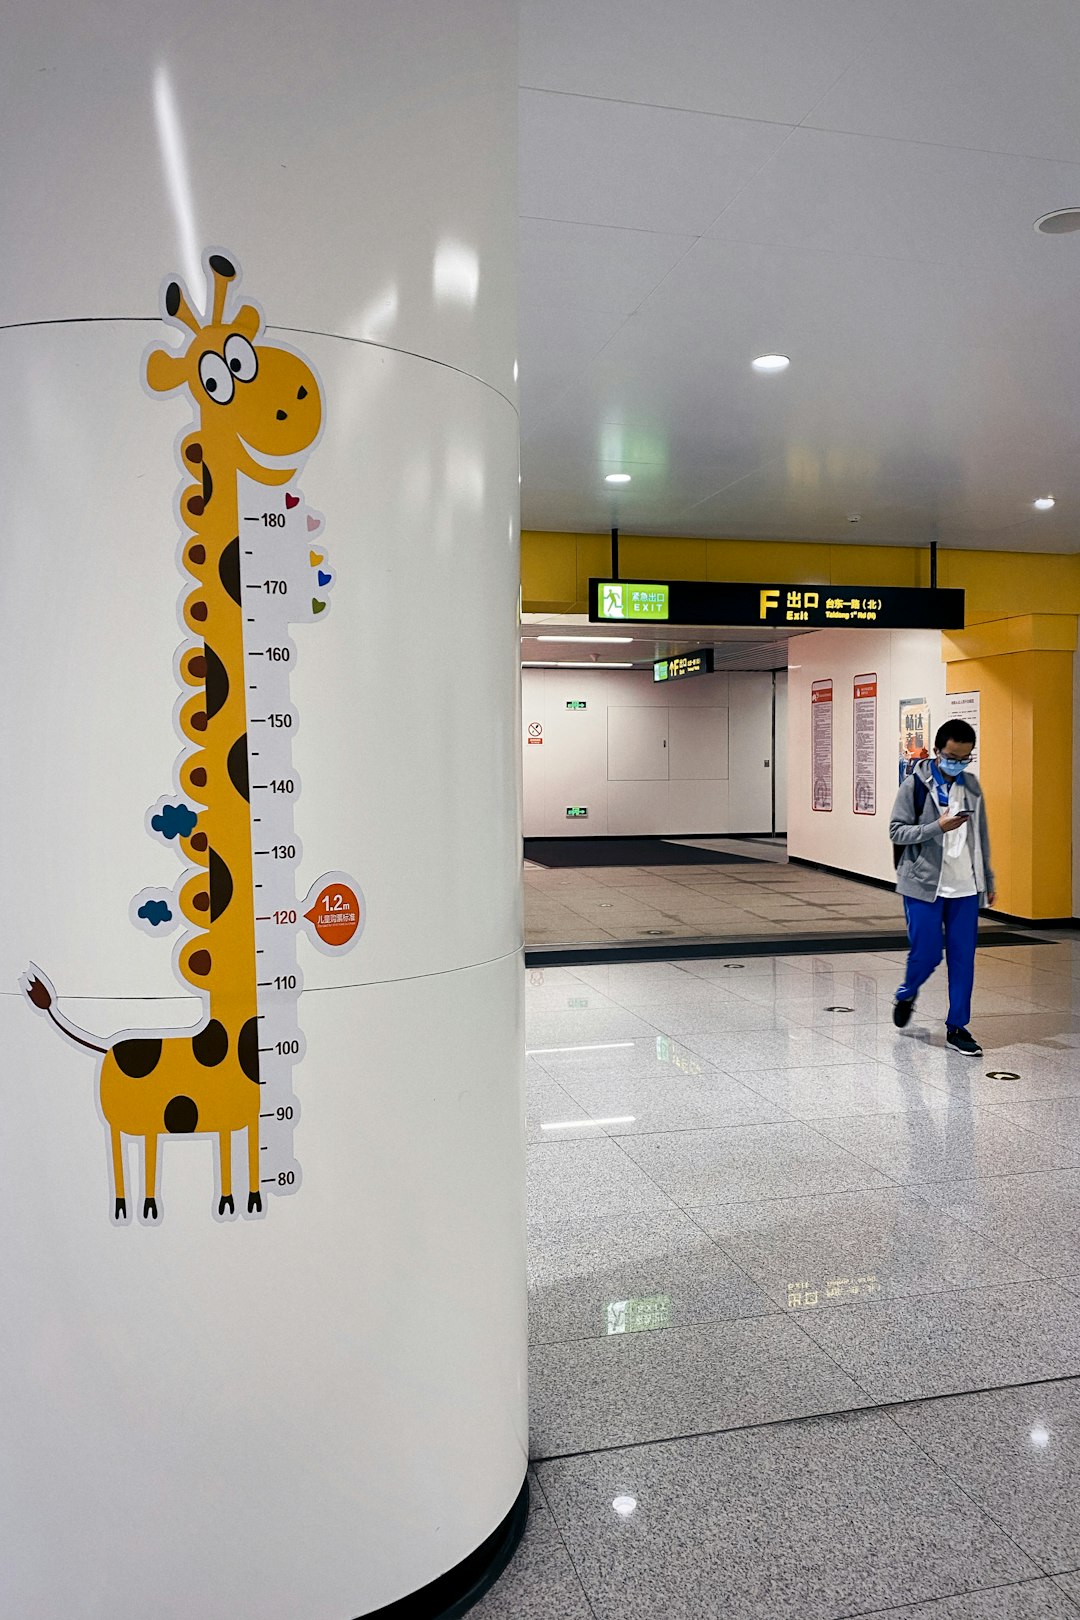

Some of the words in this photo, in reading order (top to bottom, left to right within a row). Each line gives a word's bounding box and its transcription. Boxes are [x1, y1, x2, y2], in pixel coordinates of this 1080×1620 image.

[261, 513, 286, 528] 180
[264, 580, 288, 595] 170
[632, 592, 665, 602] 紧急出口
[760, 590, 780, 619] F
[786, 590, 819, 608] 出口
[634, 604, 663, 612] EXIT
[786, 610, 809, 620] Exit
[266, 648, 290, 662] 160
[268, 714, 292, 728] 150
[270, 780, 295, 794] 140
[272, 845, 296, 860] 130
[322, 894, 350, 911] 1.2m
[273, 910, 297, 925] 120
[274, 976, 297, 991] 110
[275, 1040, 300, 1056] 100
[277, 1106, 294, 1121] 90
[278, 1171, 295, 1187] 80
